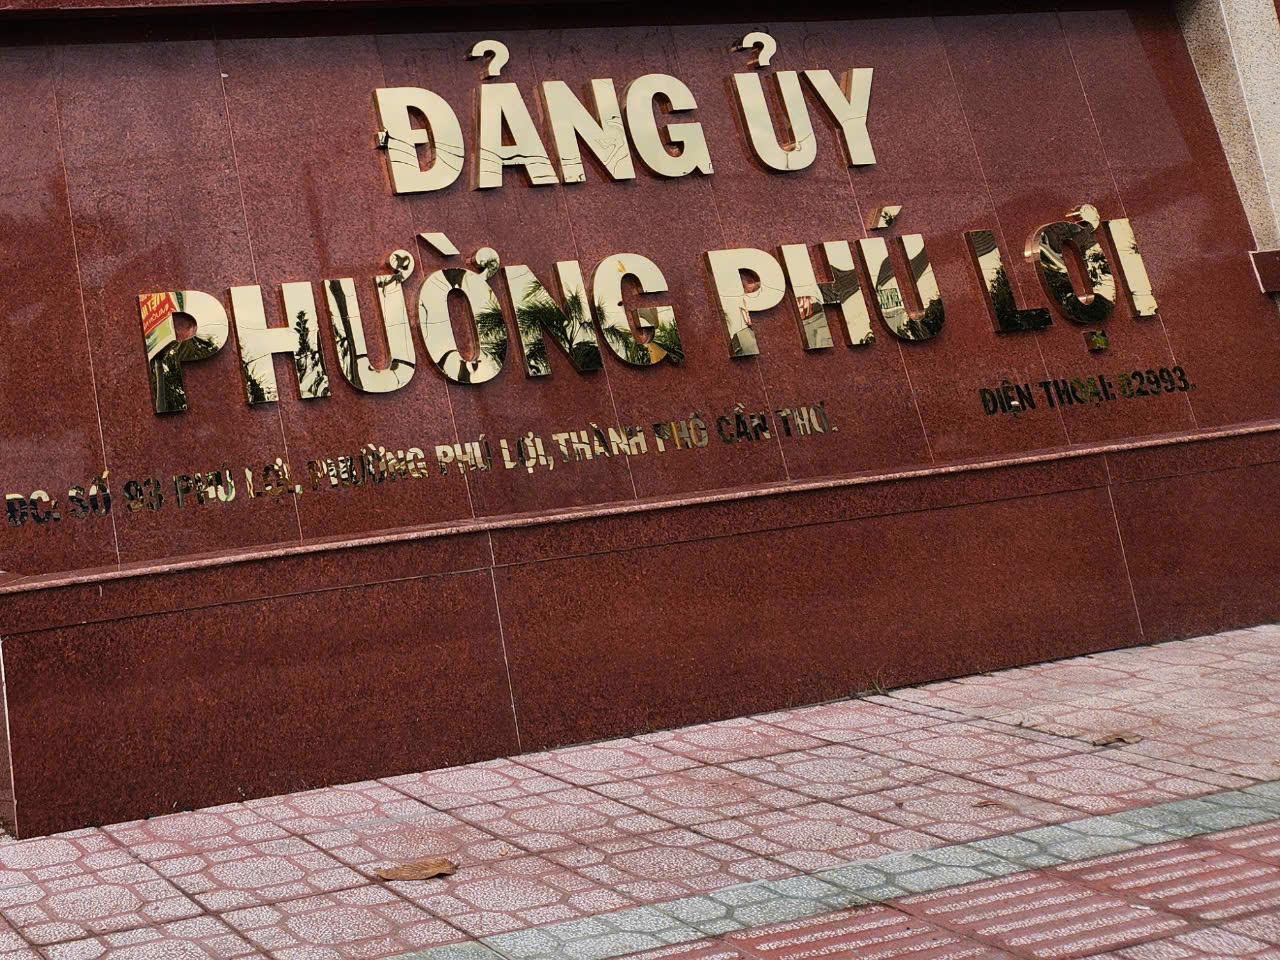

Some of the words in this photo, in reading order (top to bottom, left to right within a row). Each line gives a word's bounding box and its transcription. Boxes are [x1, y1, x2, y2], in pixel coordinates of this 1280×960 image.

[376, 39, 714, 194] ĐẢNG
[729, 32, 876, 171] ỦY
[137, 232, 684, 413] PHƯỜNG
[705, 205, 945, 357] PHÚ
[965, 203, 1159, 351] LỢI
[68, 470, 111, 519] SỐ
[123, 477, 163, 513] 93
[307, 443, 428, 491] PHƯỜNG
[435, 433, 492, 476] PHÚ
[552, 422, 648, 462] THÀNH
[652, 408, 709, 452] PHỐ
[716, 402, 771, 444] CẦN
[978, 379, 1036, 418] ĐIỆN
